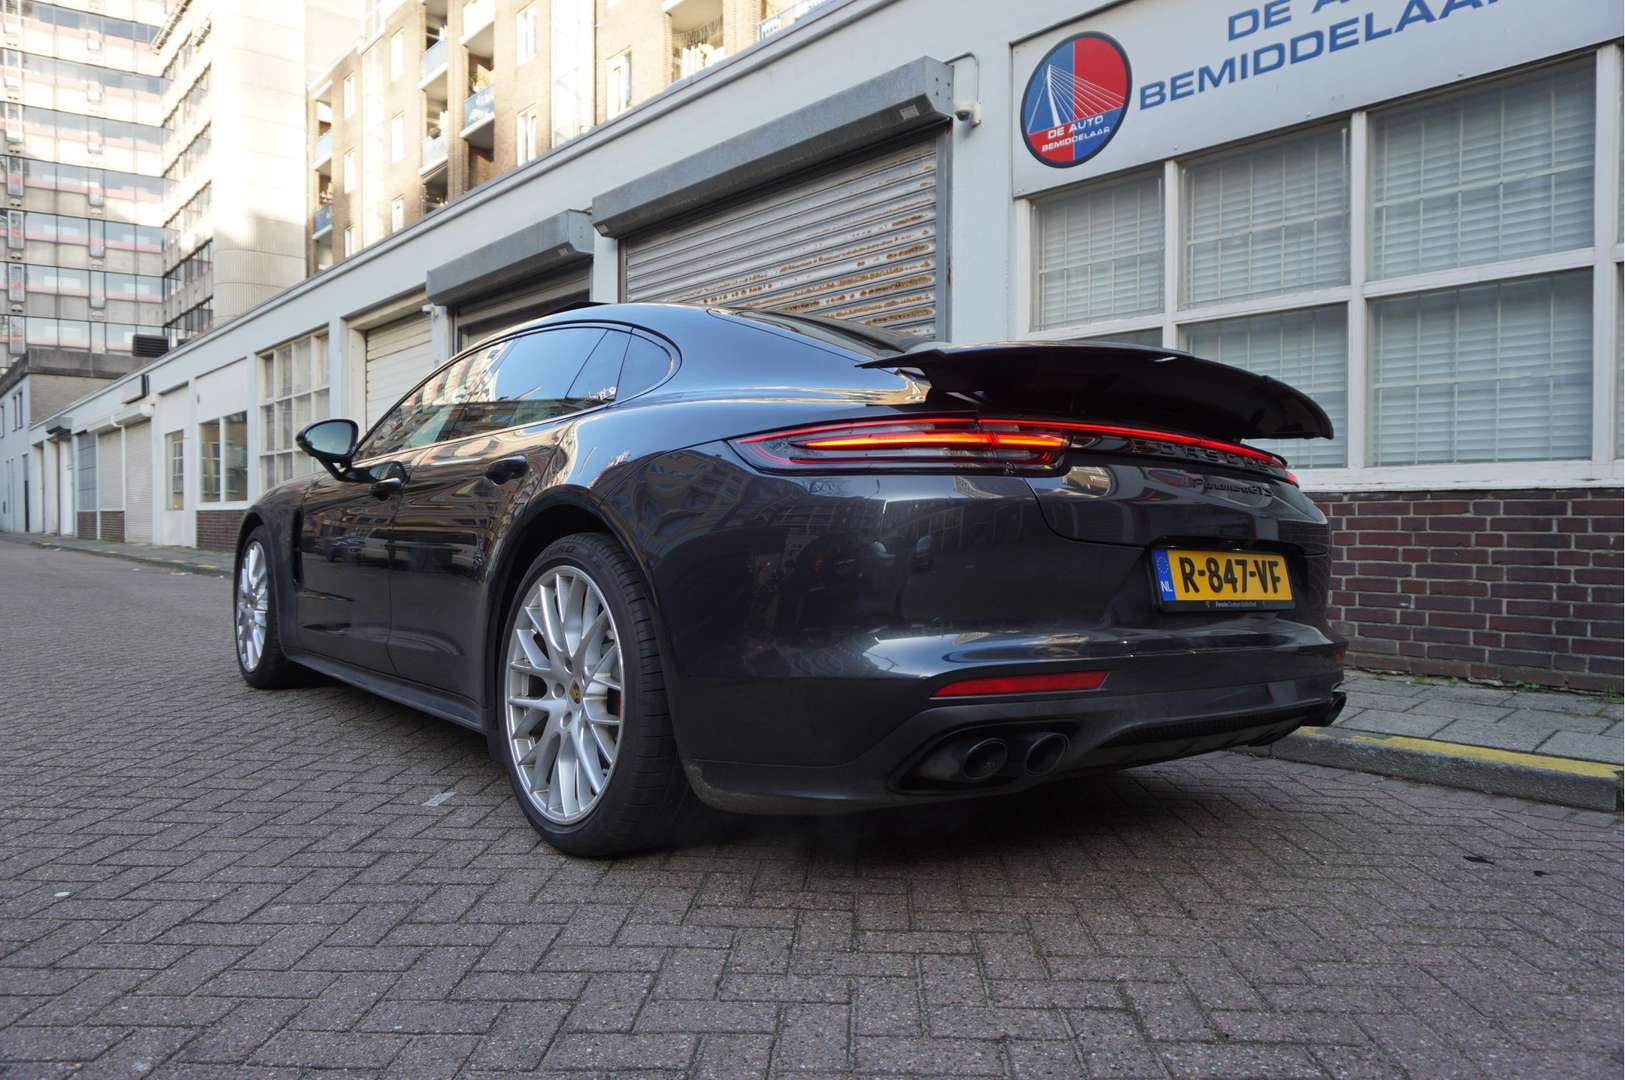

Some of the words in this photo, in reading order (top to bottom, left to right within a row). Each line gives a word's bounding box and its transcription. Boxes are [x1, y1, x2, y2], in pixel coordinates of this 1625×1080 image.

[1228, 0, 1292, 41] DE
[1139, 0, 1498, 111] BEMIDDELA
[1041, 126, 1111, 152] BEMIDDELAAR
[1047, 126, 1065, 140] DE
[1068, 115, 1104, 133] AUTO
[1160, 580, 1173, 593] NL
[1178, 556, 1281, 594] R-847-VF
